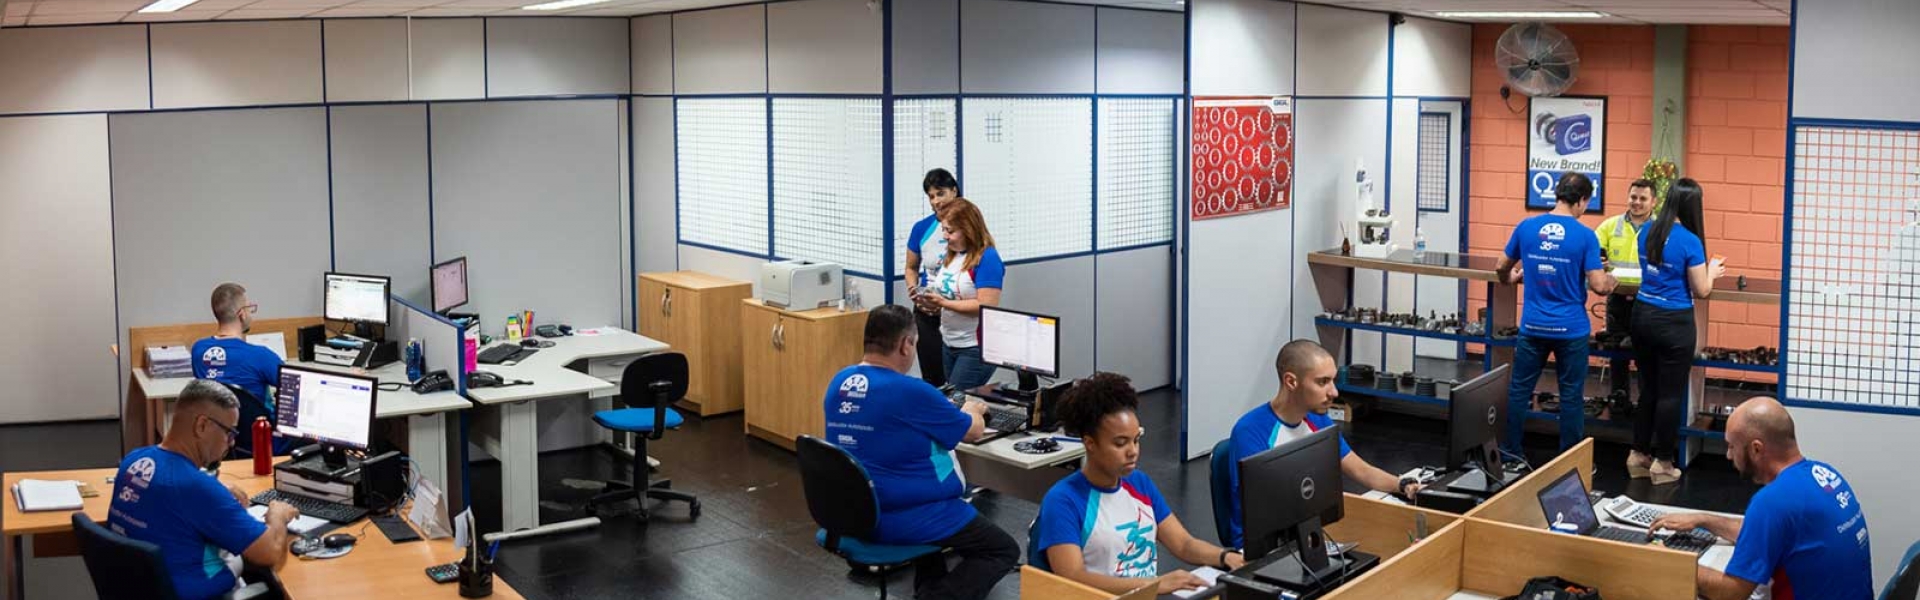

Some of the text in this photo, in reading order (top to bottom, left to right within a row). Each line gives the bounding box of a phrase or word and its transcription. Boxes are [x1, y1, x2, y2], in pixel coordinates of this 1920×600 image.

[1530, 158, 1601, 171] New Brand!
[839, 401, 853, 414] 35
